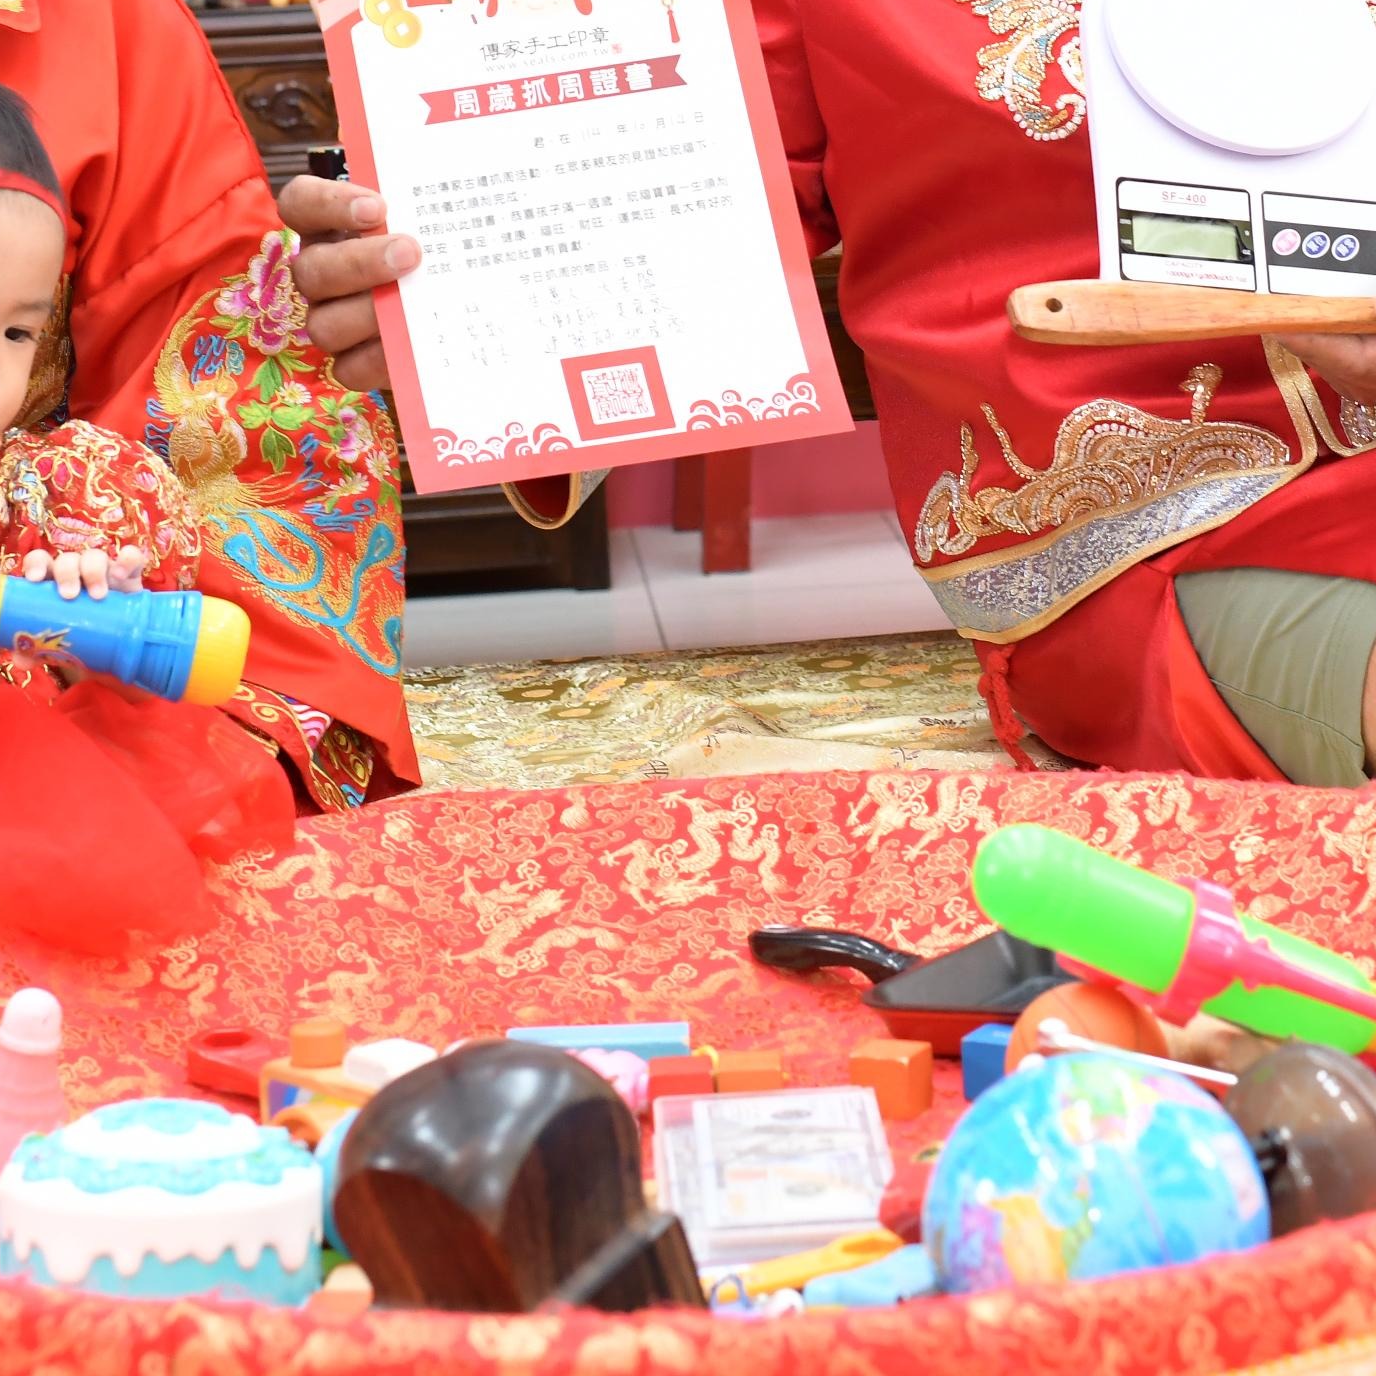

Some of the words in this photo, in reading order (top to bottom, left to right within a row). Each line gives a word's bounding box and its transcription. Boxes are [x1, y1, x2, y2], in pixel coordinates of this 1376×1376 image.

[479, 25, 610, 62] 傳家手工印章
[451, 63, 654, 116] 周歲抓周證書
[1161, 191, 1207, 204] SF-400
